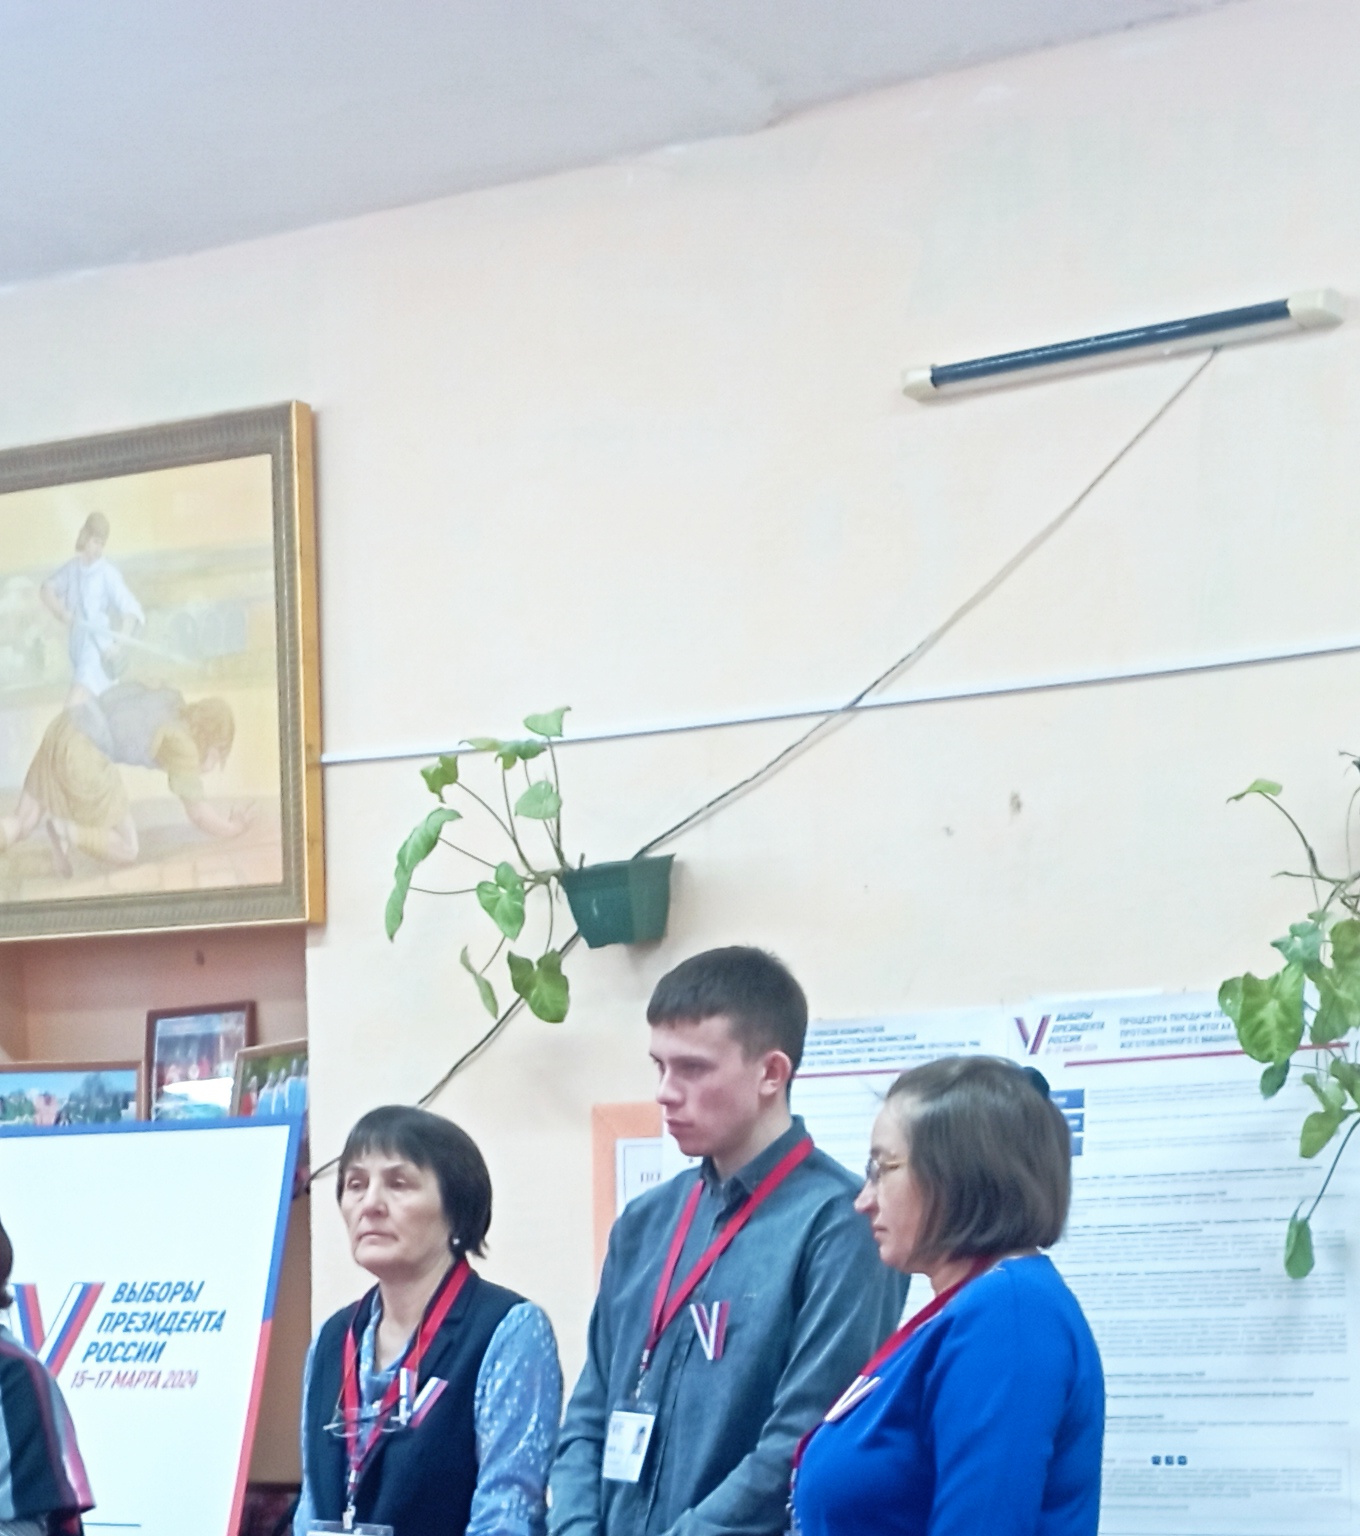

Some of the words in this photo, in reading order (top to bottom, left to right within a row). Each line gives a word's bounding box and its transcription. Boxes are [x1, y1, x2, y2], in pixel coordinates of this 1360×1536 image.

[111, 1281, 205, 1303] ВЫБОРЫ
[97, 1310, 227, 1336] ПРЕЗИДЕНТА
[82, 1341, 167, 1363] РОССИИ
[111, 1370, 162, 1389] МАРТА
[162, 1370, 198, 1389] 2024
